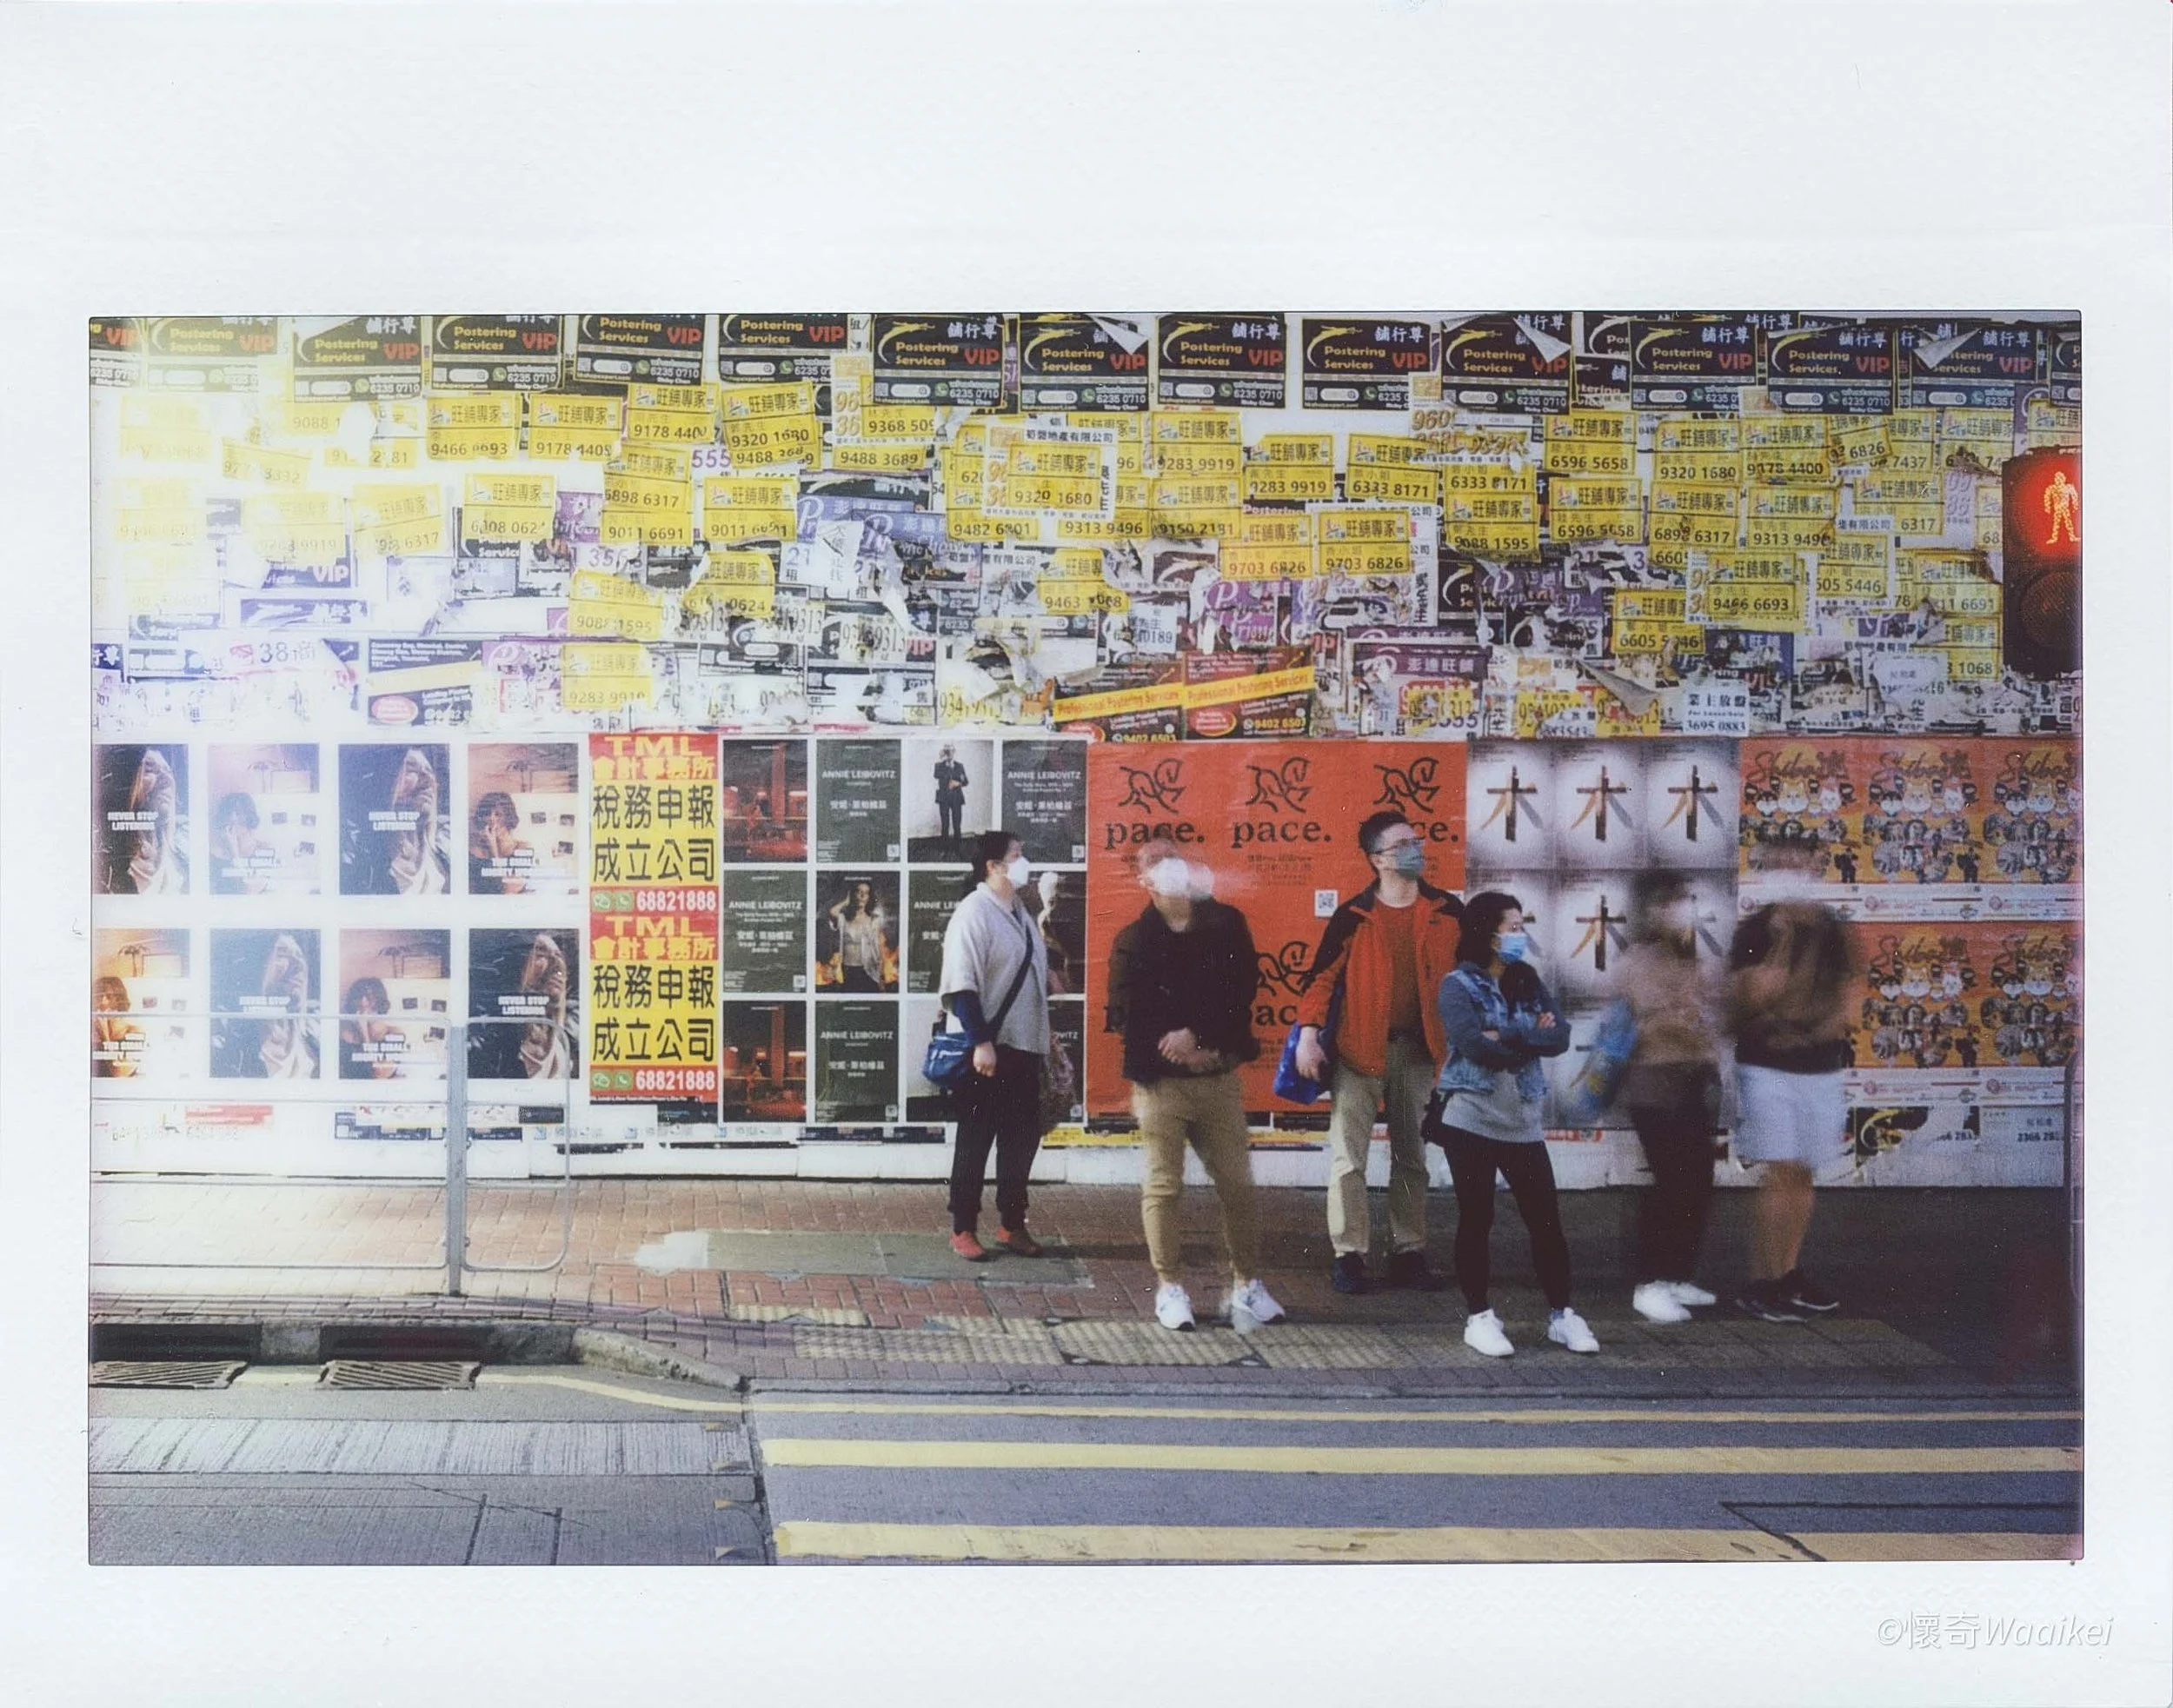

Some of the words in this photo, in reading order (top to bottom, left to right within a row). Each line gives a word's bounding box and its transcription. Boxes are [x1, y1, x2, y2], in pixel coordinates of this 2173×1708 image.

[600, 318, 661, 332] Postering
[741, 319, 803, 331] Postering
[170, 329, 234, 341] Postering
[454, 326, 515, 338] Postering
[600, 332, 648, 342] Services
[667, 327, 701, 344] VIP
[741, 333, 791, 344] Services
[809, 326, 845, 342] VIP
[240, 334, 275, 352] VIP
[315, 340, 377, 349] Postering
[454, 340, 503, 349] Services
[522, 332, 557, 349] VIP
[170, 342, 221, 353] Services
[384, 343, 418, 359] VIP
[895, 342, 958, 354] Postering
[1042, 348, 1104, 360] Postering
[1180, 342, 1242, 355] Postering
[1324, 346, 1386, 358] Postering
[315, 353, 365, 362] Services
[895, 356, 946, 365] Services
[964, 349, 1000, 364] VIP
[1180, 355, 1230, 366] Services
[1248, 349, 1283, 366] VIP
[1392, 352, 1427, 369] VIP
[1464, 349, 1525, 362] Postering
[1652, 349, 1713, 360] Postering
[1718, 353, 1752, 369] VIP
[1789, 350, 1850, 362] Postering
[1042, 362, 1092, 372] Services
[1110, 353, 1146, 370] VIP
[1324, 359, 1374, 369] Services
[1464, 362, 1513, 373] Services
[1652, 362, 1701, 372] Services
[1856, 356, 1890, 373] VIP
[2000, 356, 2035, 372] VIP
[1789, 364, 1837, 374] Services
[294, 417, 329, 429] 9088
[868, 420, 904, 433] 9368
[634, 424, 669, 438] 9178
[731, 432, 768, 449] 9320
[431, 442, 466, 456] 9466
[536, 442, 571, 455] 9178
[1850, 442, 1885, 458] 6826
[737, 449, 772, 465] 9488
[840, 451, 876, 464] 9488
[884, 454, 919, 466] 3689
[1551, 455, 1586, 470] 6596
[1593, 456, 1628, 470] 5658
[1892, 456, 1927, 469] 7437
[1199, 458, 1234, 471] 9919
[1747, 462, 1783, 477] 9178
[1789, 462, 1824, 475] 4400
[1660, 467, 1695, 480] 9320
[1702, 466, 1737, 480] 1680
[1291, 481, 1326, 494] 9919
[1352, 480, 1389, 495] 6333
[1393, 483, 1428, 498] 8171
[1450, 476, 1486, 489] 6333
[643, 491, 679, 508] 6317
[1014, 489, 1050, 504] 9320
[1058, 492, 1092, 505] 1680
[711, 524, 746, 537] 9011
[954, 523, 988, 536] 9482
[1066, 521, 1101, 535] 9313
[1106, 522, 1143, 535] 9496
[1558, 524, 1594, 538] 6596
[1902, 518, 1935, 531] 6317
[608, 527, 642, 540] 9011
[649, 528, 684, 540] 6691
[1694, 530, 1729, 543] 6317
[1753, 533, 1789, 546] 9313
[1495, 538, 1529, 550] 1595
[1230, 562, 1265, 575] 9703
[1326, 558, 1361, 571] 9703
[1367, 556, 1403, 569] 6826
[313, 565, 349, 582] VIP
[1845, 580, 1881, 592] 5446
[1045, 596, 1080, 609] 9463
[1713, 597, 1748, 610] 9466
[1753, 597, 1789, 610] 6693
[1620, 635, 1656, 648] 6605
[1957, 661, 1992, 675] 1068
[605, 737, 703, 756] TML
[821, 770, 849, 779] ANNIE
[852, 769, 896, 779] LEIBOVITZ
[1007, 771, 1034, 780] ANNIE
[1037, 770, 1080, 780] LEIBOVITZ
[108, 812, 136, 821] NEVER
[137, 812, 158, 821] STOP
[1106, 821, 1205, 849] pace.
[1232, 821, 1332, 848] pace.
[594, 838, 714, 882] 成立公司
[636, 890, 716, 912] 68821888
[728, 901, 756, 910] ANNIE
[758, 900, 802, 910] LEIBOVITZ
[605, 917, 703, 937] TML
[593, 1018, 714, 1061] 成立公司
[821, 1031, 848, 1040] ANNIE
[849, 1031, 894, 1040] LEIBOVITZ
[635, 1070, 715, 1091] 68821888
